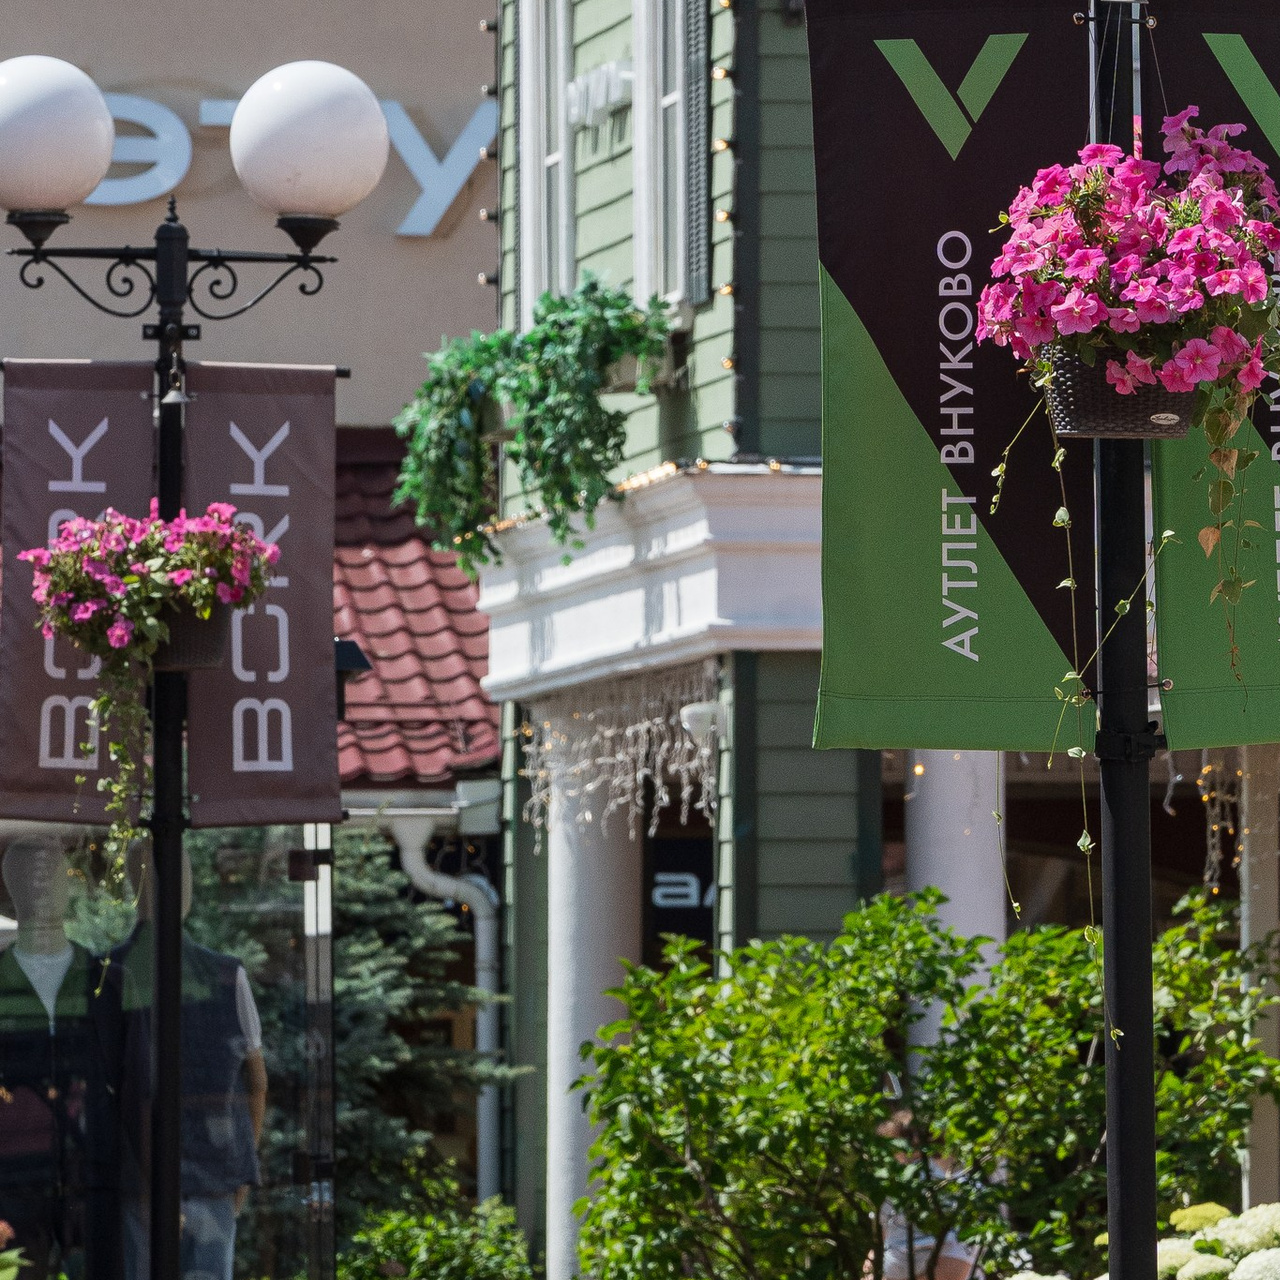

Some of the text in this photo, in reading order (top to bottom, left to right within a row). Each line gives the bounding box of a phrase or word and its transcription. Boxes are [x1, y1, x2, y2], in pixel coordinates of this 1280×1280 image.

[38, 418, 108, 770] BOK
[937, 230, 979, 662] АУТЛЕТ ВНУКОВО
